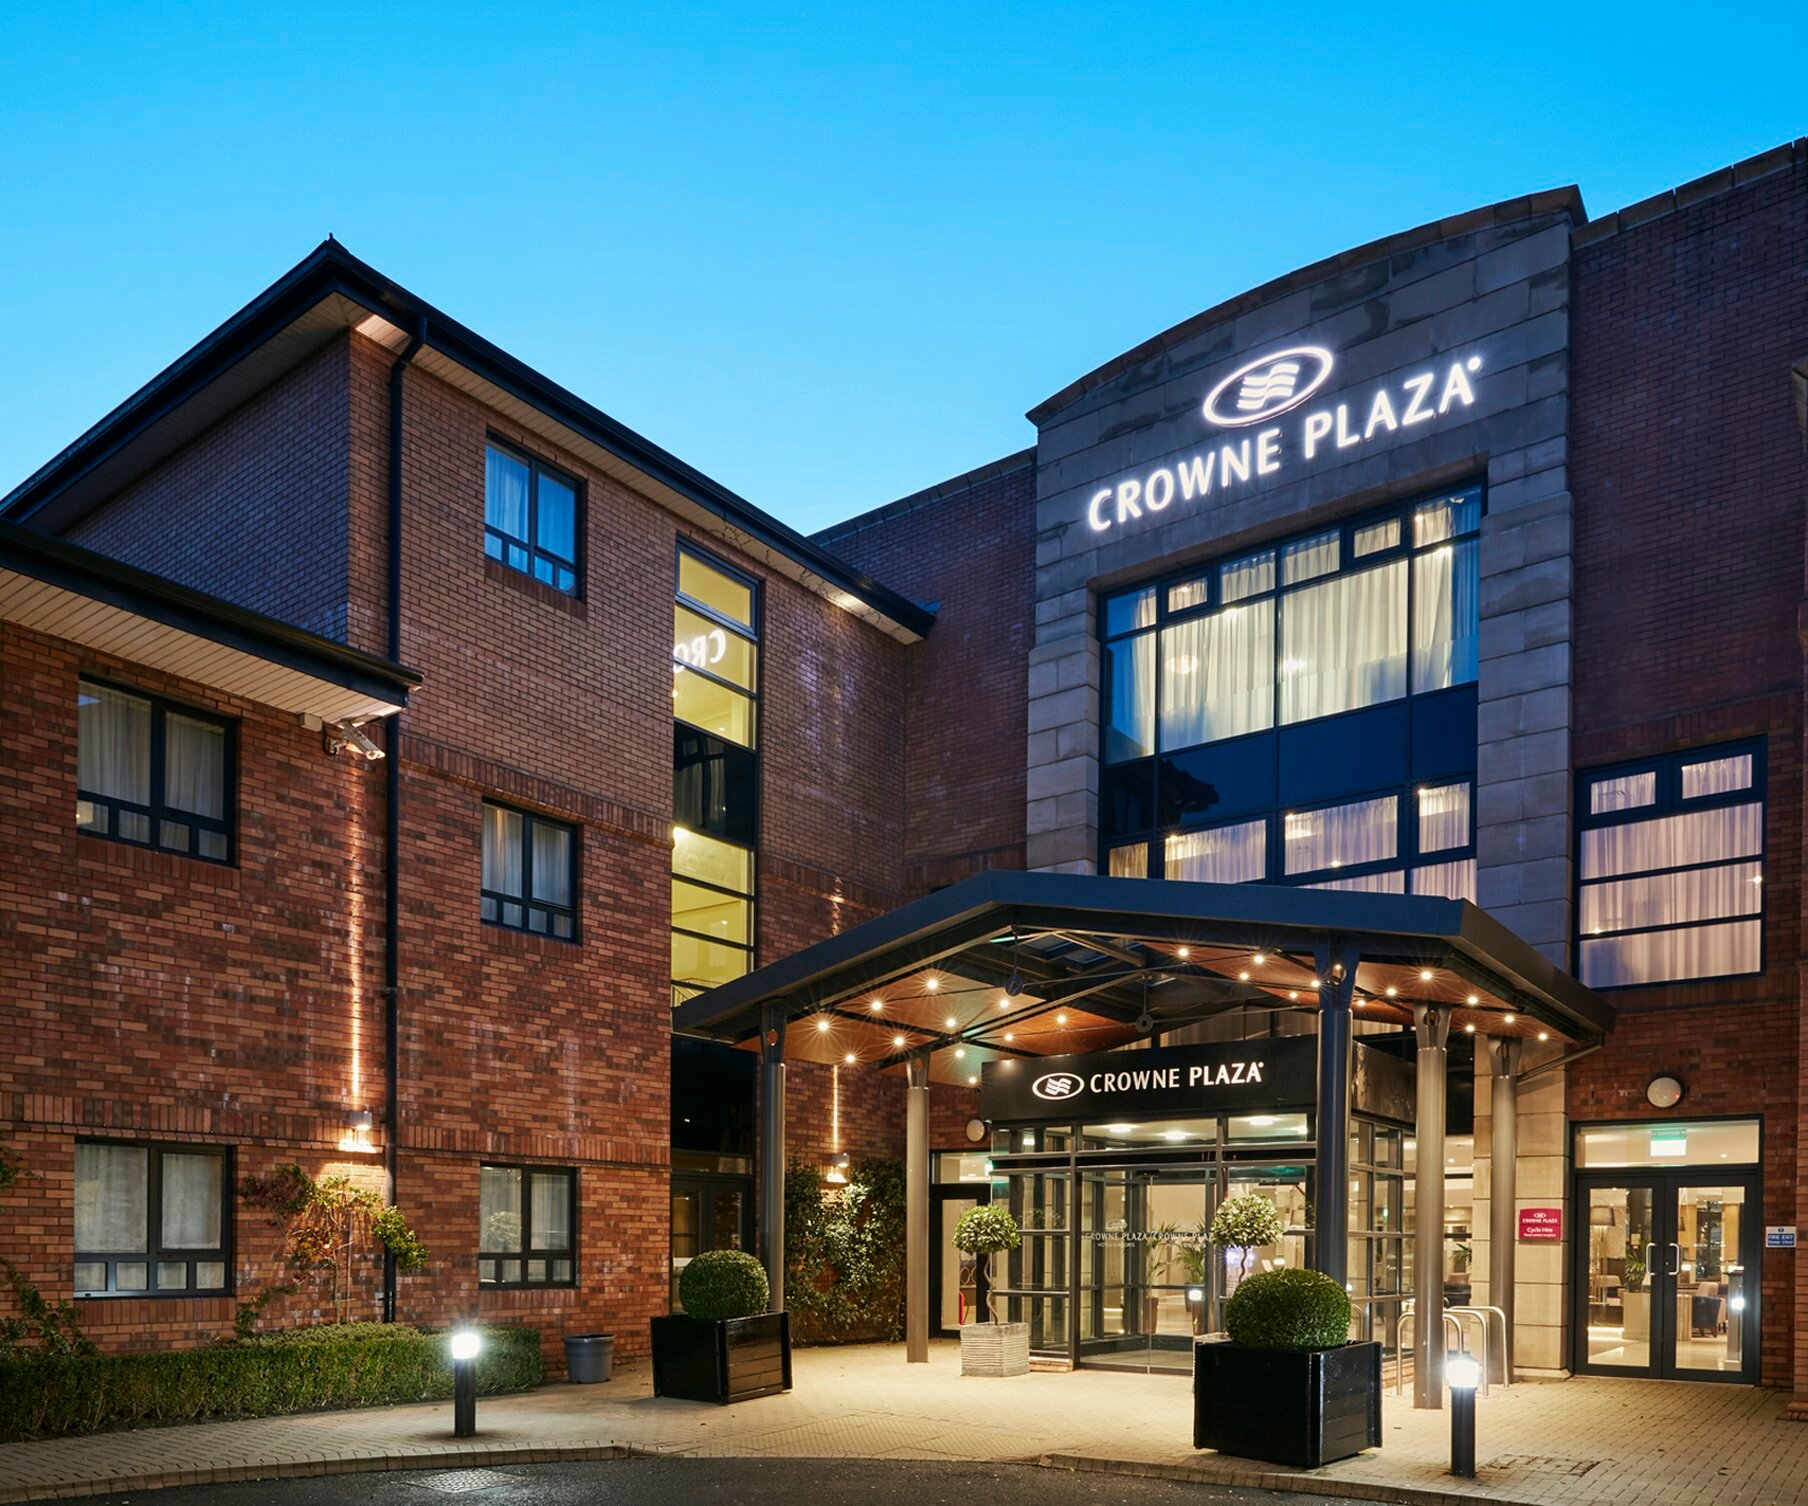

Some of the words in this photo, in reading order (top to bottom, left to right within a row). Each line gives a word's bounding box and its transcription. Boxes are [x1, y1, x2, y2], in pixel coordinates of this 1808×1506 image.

[1088, 428, 1281, 531] CROWNE
[1304, 363, 1475, 459] PLAZA
[1089, 1068, 1180, 1093] CROWNE
[1189, 1062, 1262, 1087] PLAZA
[1121, 1232, 1148, 1241] PLAZA
